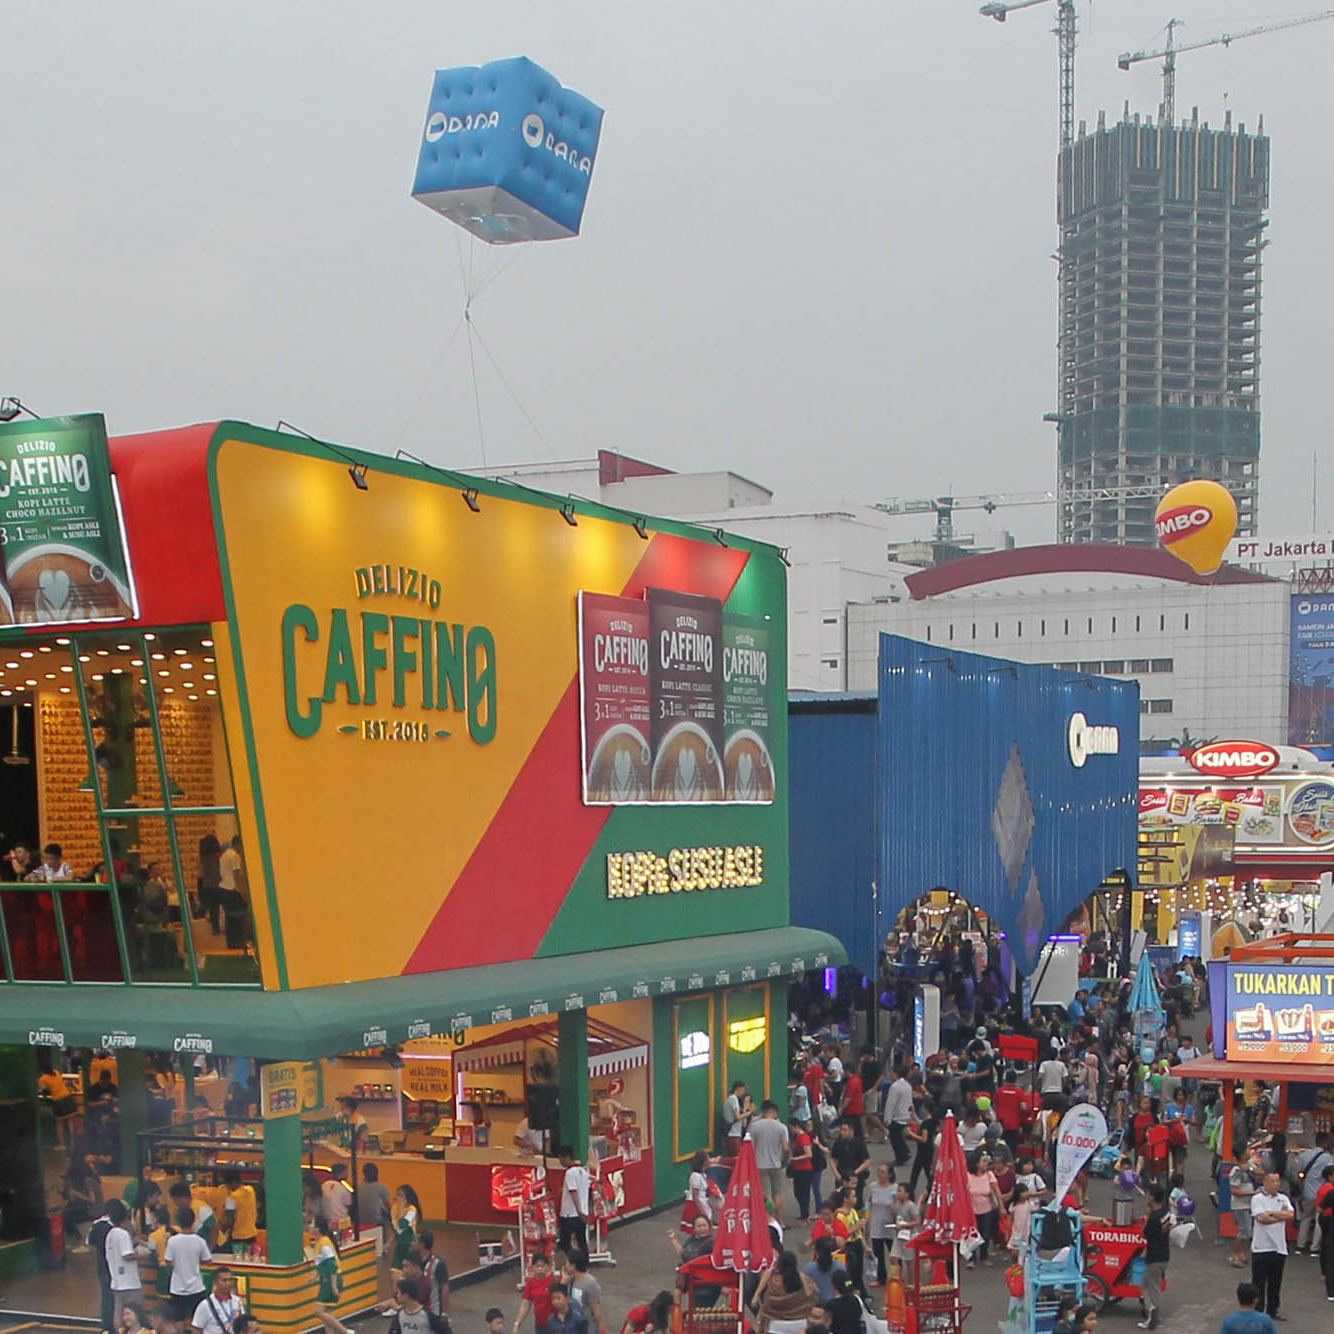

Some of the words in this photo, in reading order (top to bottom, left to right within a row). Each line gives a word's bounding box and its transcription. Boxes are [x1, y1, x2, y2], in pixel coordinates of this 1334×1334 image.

[17, 440, 56, 454] DELIZIO
[6, 509, 36, 519] CHOCO
[38, 506, 86, 516] HAZELNUT
[18, 500, 39, 509] KOPI
[42, 497, 70, 506] LATTE
[1155, 509, 1210, 537] IMBO
[0, 527, 9, 545] 3
[16, 526, 25, 541] 1
[1238, 543, 1258, 557] PT
[1264, 541, 1326, 557] Jakarta
[354, 564, 442, 609] DELIZIO
[594, 633, 649, 676] CAFFINO
[660, 630, 713, 673] CAFFINO
[282, 603, 497, 745] CAFFINO
[723, 647, 767, 686] CAFFINO
[1195, 750, 1276, 768] KIMBO
[1234, 972, 1321, 995] TUKARKAN
